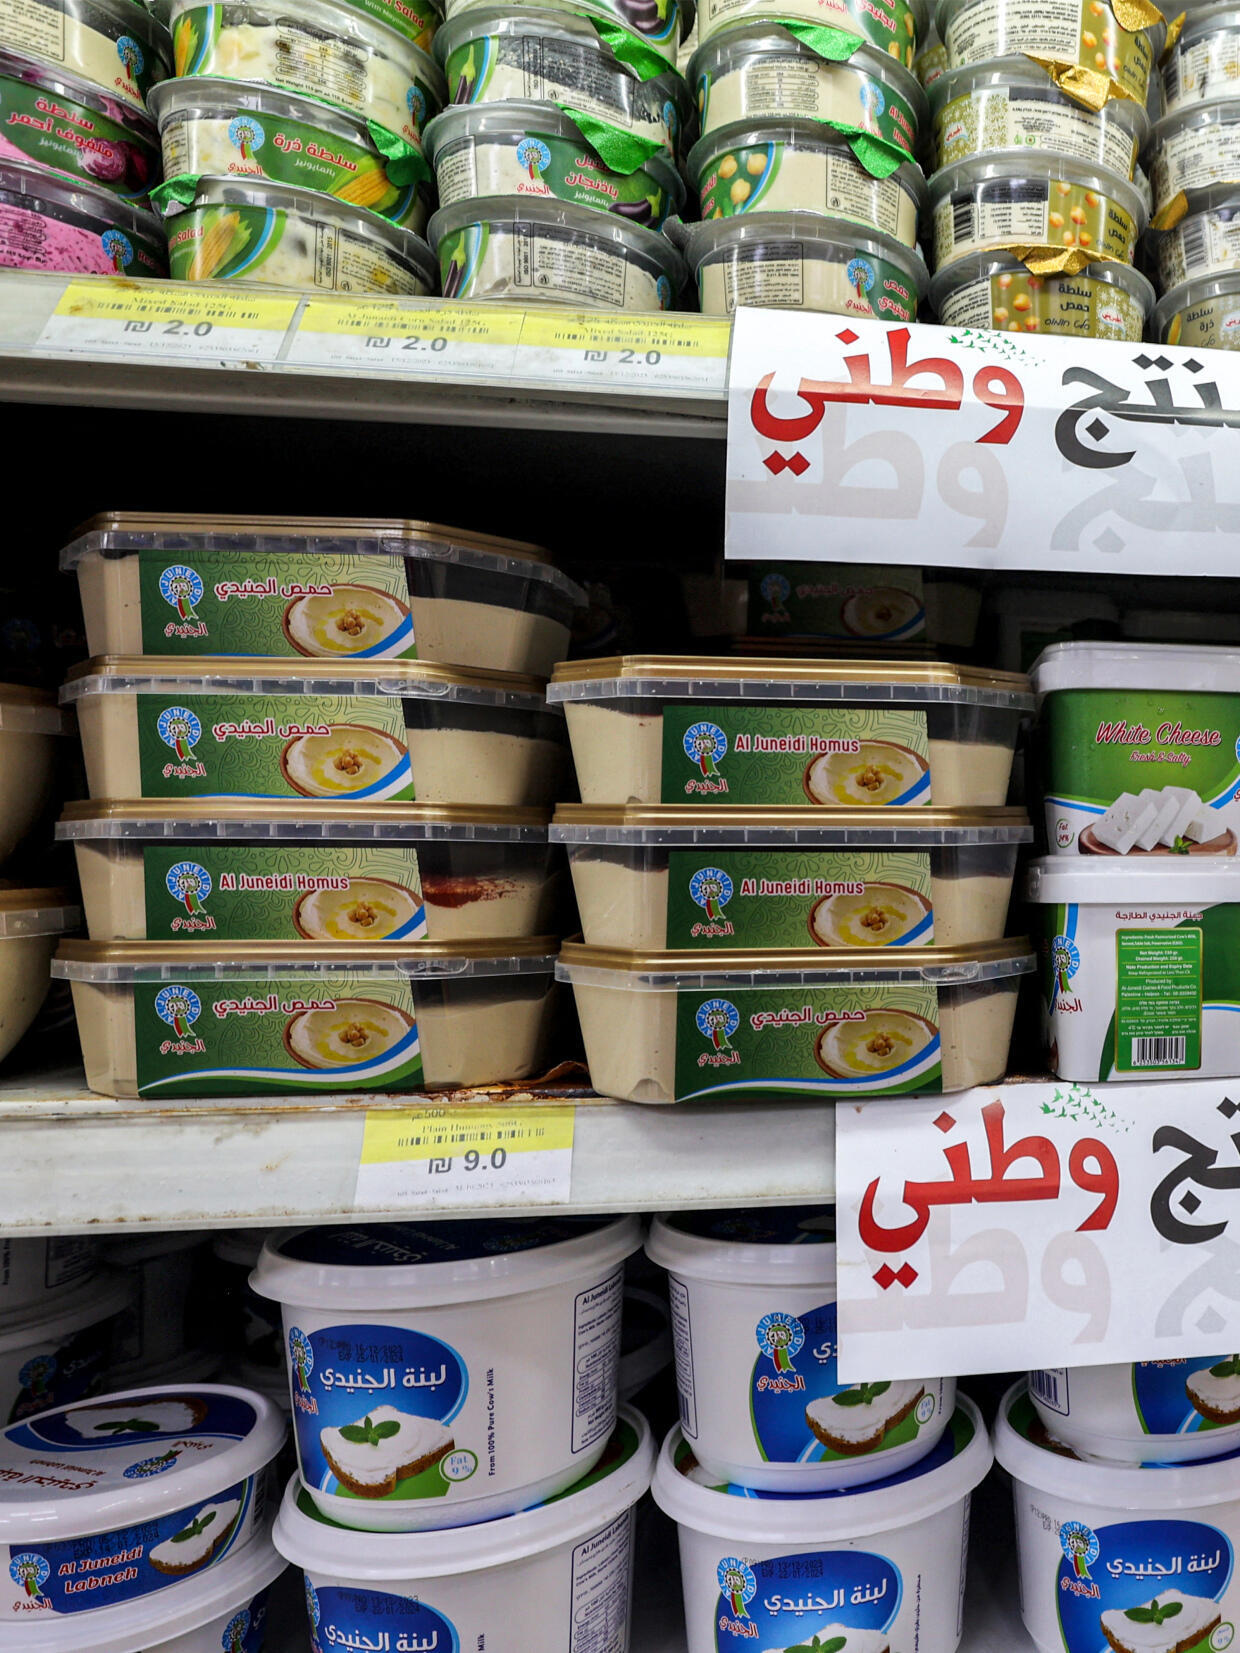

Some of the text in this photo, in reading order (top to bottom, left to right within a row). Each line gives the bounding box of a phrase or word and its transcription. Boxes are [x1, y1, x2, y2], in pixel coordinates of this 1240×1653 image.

[35, 97, 95, 131] سلطة
[56, 127, 114, 159] ملفوف
[273, 133, 358, 172] سلطة ذرة
[565, 172, 618, 200] باذنجان
[1058, 284, 1092, 298] سلطة
[1060, 301, 1090, 312] حمص
[163, 319, 213, 337] 2.0
[402, 335, 448, 352] 2.0
[618, 348, 661, 366] 2.0
[750, 327, 1025, 477] وطني
[215, 580, 333, 600] حمص الجنيدي
[213, 720, 331, 742] حمص الجنيدي
[1095, 720, 1222, 746] White Cheese
[734, 734, 861, 754] Al Juneidi Homus
[220, 872, 350, 892] Al Juneidi Homus
[741, 878, 865, 897] Al Juneidi Homus
[213, 995, 337, 1018] حمص الجنيدي
[750, 1006, 866, 1030] حمص الجنيدي
[463, 1148, 507, 1171] 9.0
[858, 1099, 1120, 1290] وطني
[319, 1364, 447, 1395] لبنة الجنيدي
[487, 1367, 496, 1383] Milk
[487, 1408, 496, 1429] Pure
[58, 1545, 144, 1577] Al Juneidi
[1106, 1550, 1222, 1581] لبنة الجنيدي
[64, 1567, 138, 1595] Labneh
[764, 1578, 888, 1614] لبنة الجنيدي
[323, 1622, 439, 1653] لبنة الجنيدي
